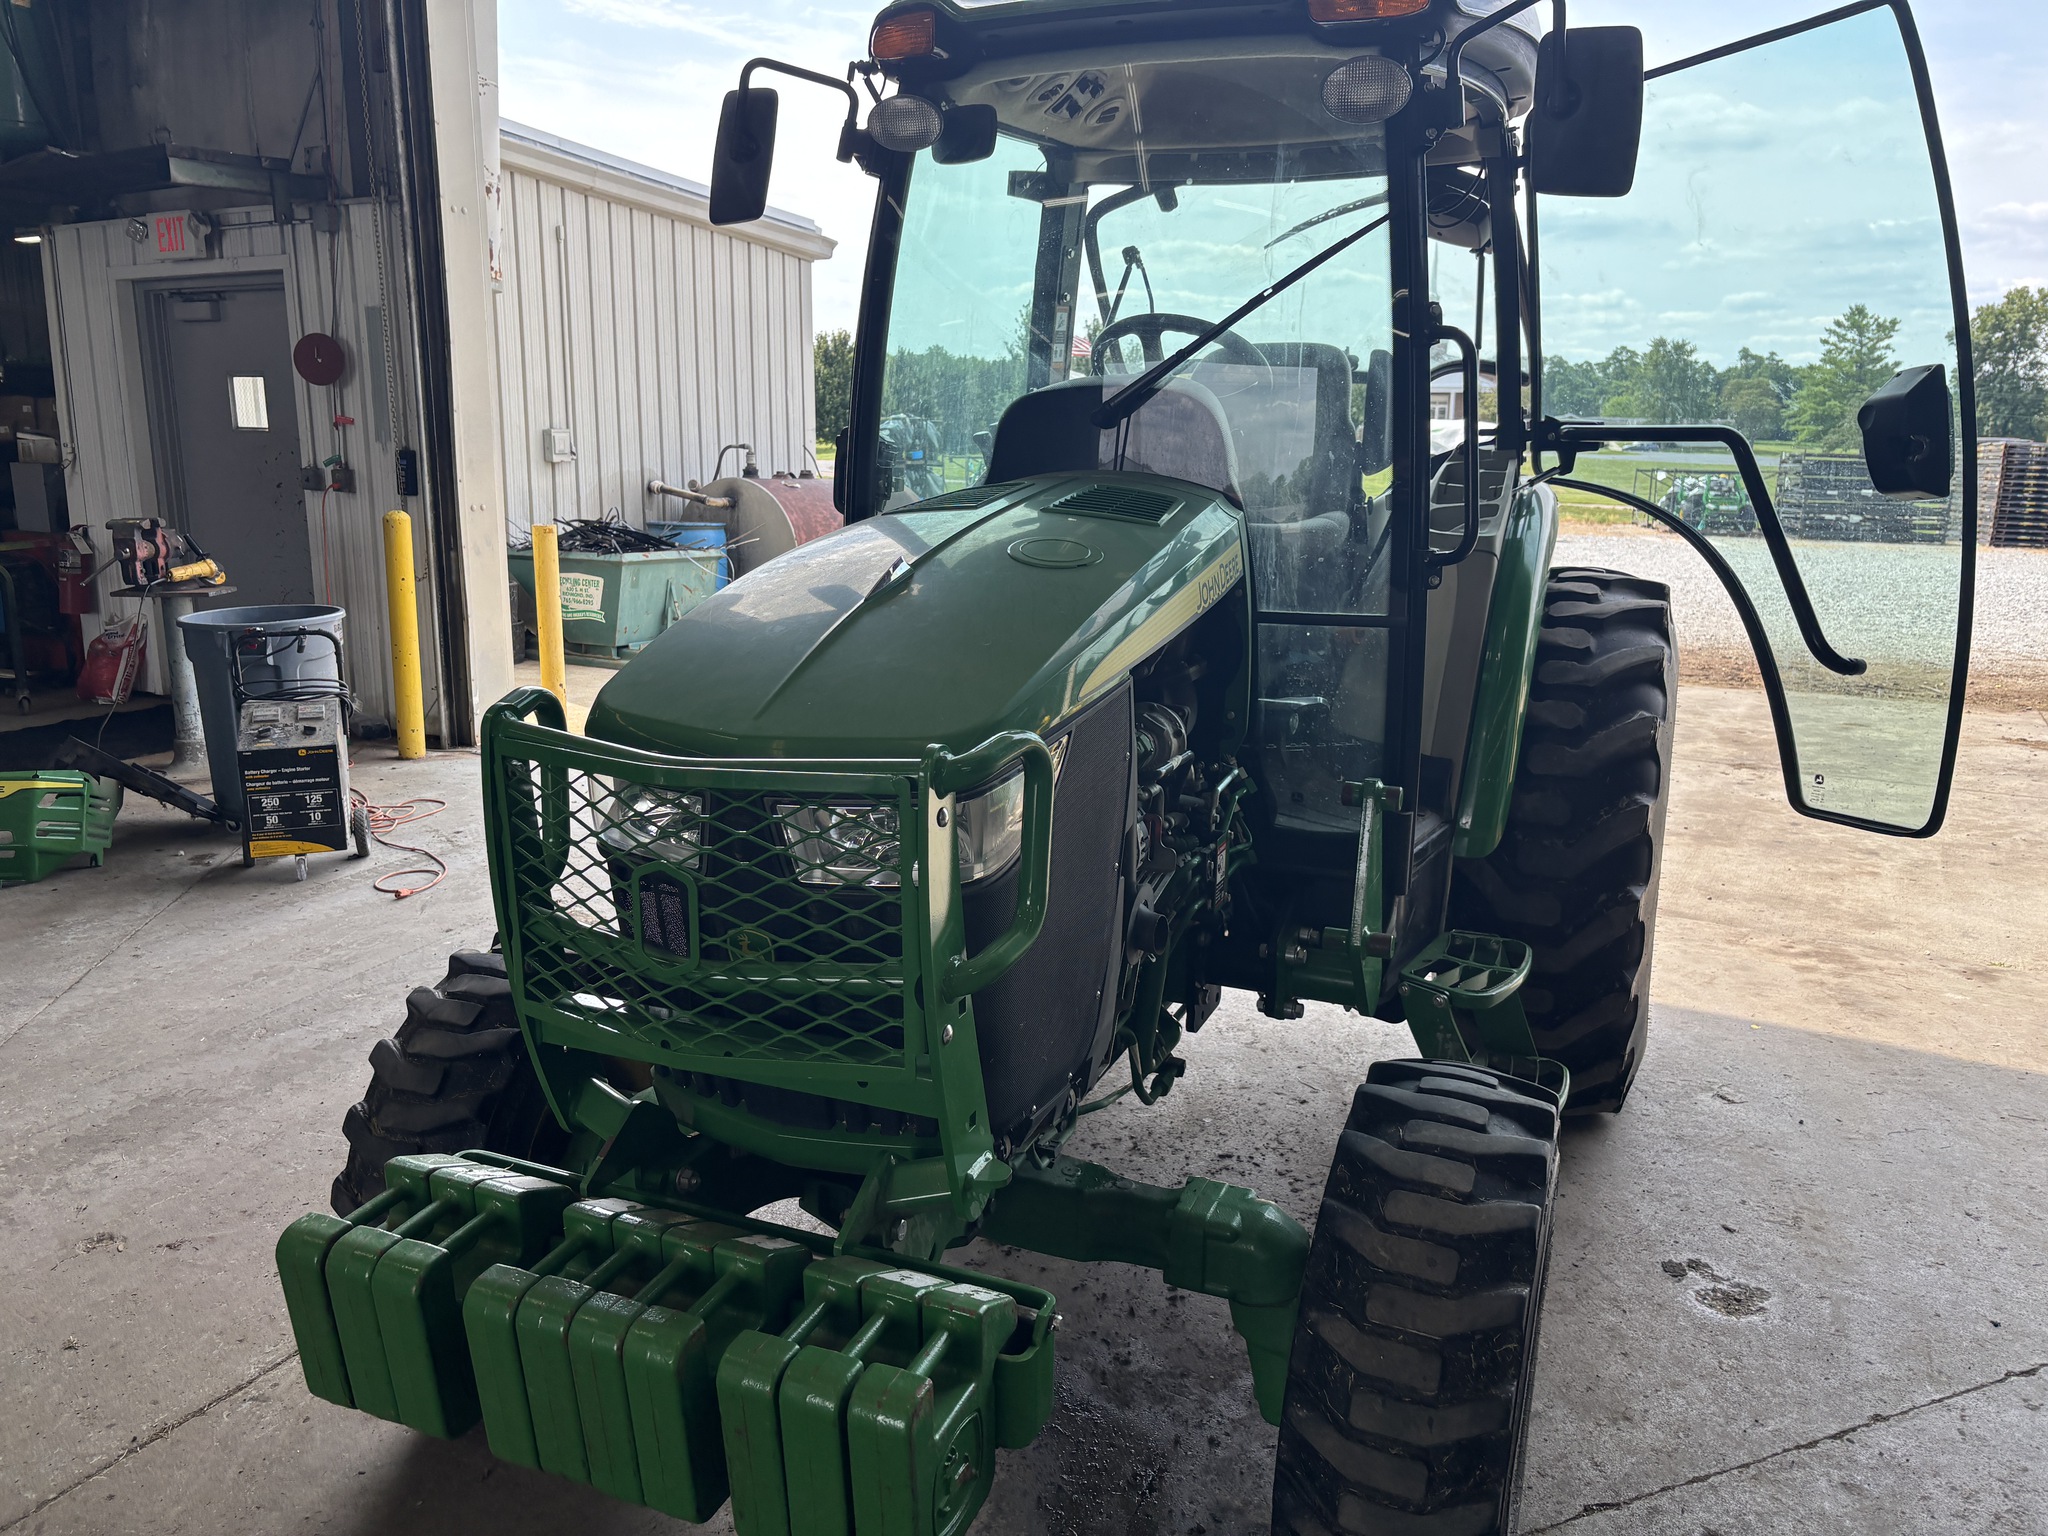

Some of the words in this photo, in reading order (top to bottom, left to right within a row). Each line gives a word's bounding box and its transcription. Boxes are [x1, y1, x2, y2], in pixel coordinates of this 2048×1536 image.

[156, 216, 185, 252] EXIT
[560, 577, 581, 586] ECYCLING
[582, 579, 600, 588] CENTER
[1196, 571, 1221, 612] JOHN
[1219, 554, 1240, 590] DEERE
[261, 797, 280, 807] 250
[305, 794, 323, 804] 125
[266, 815, 279, 824] 50
[309, 812, 322, 821] 10
